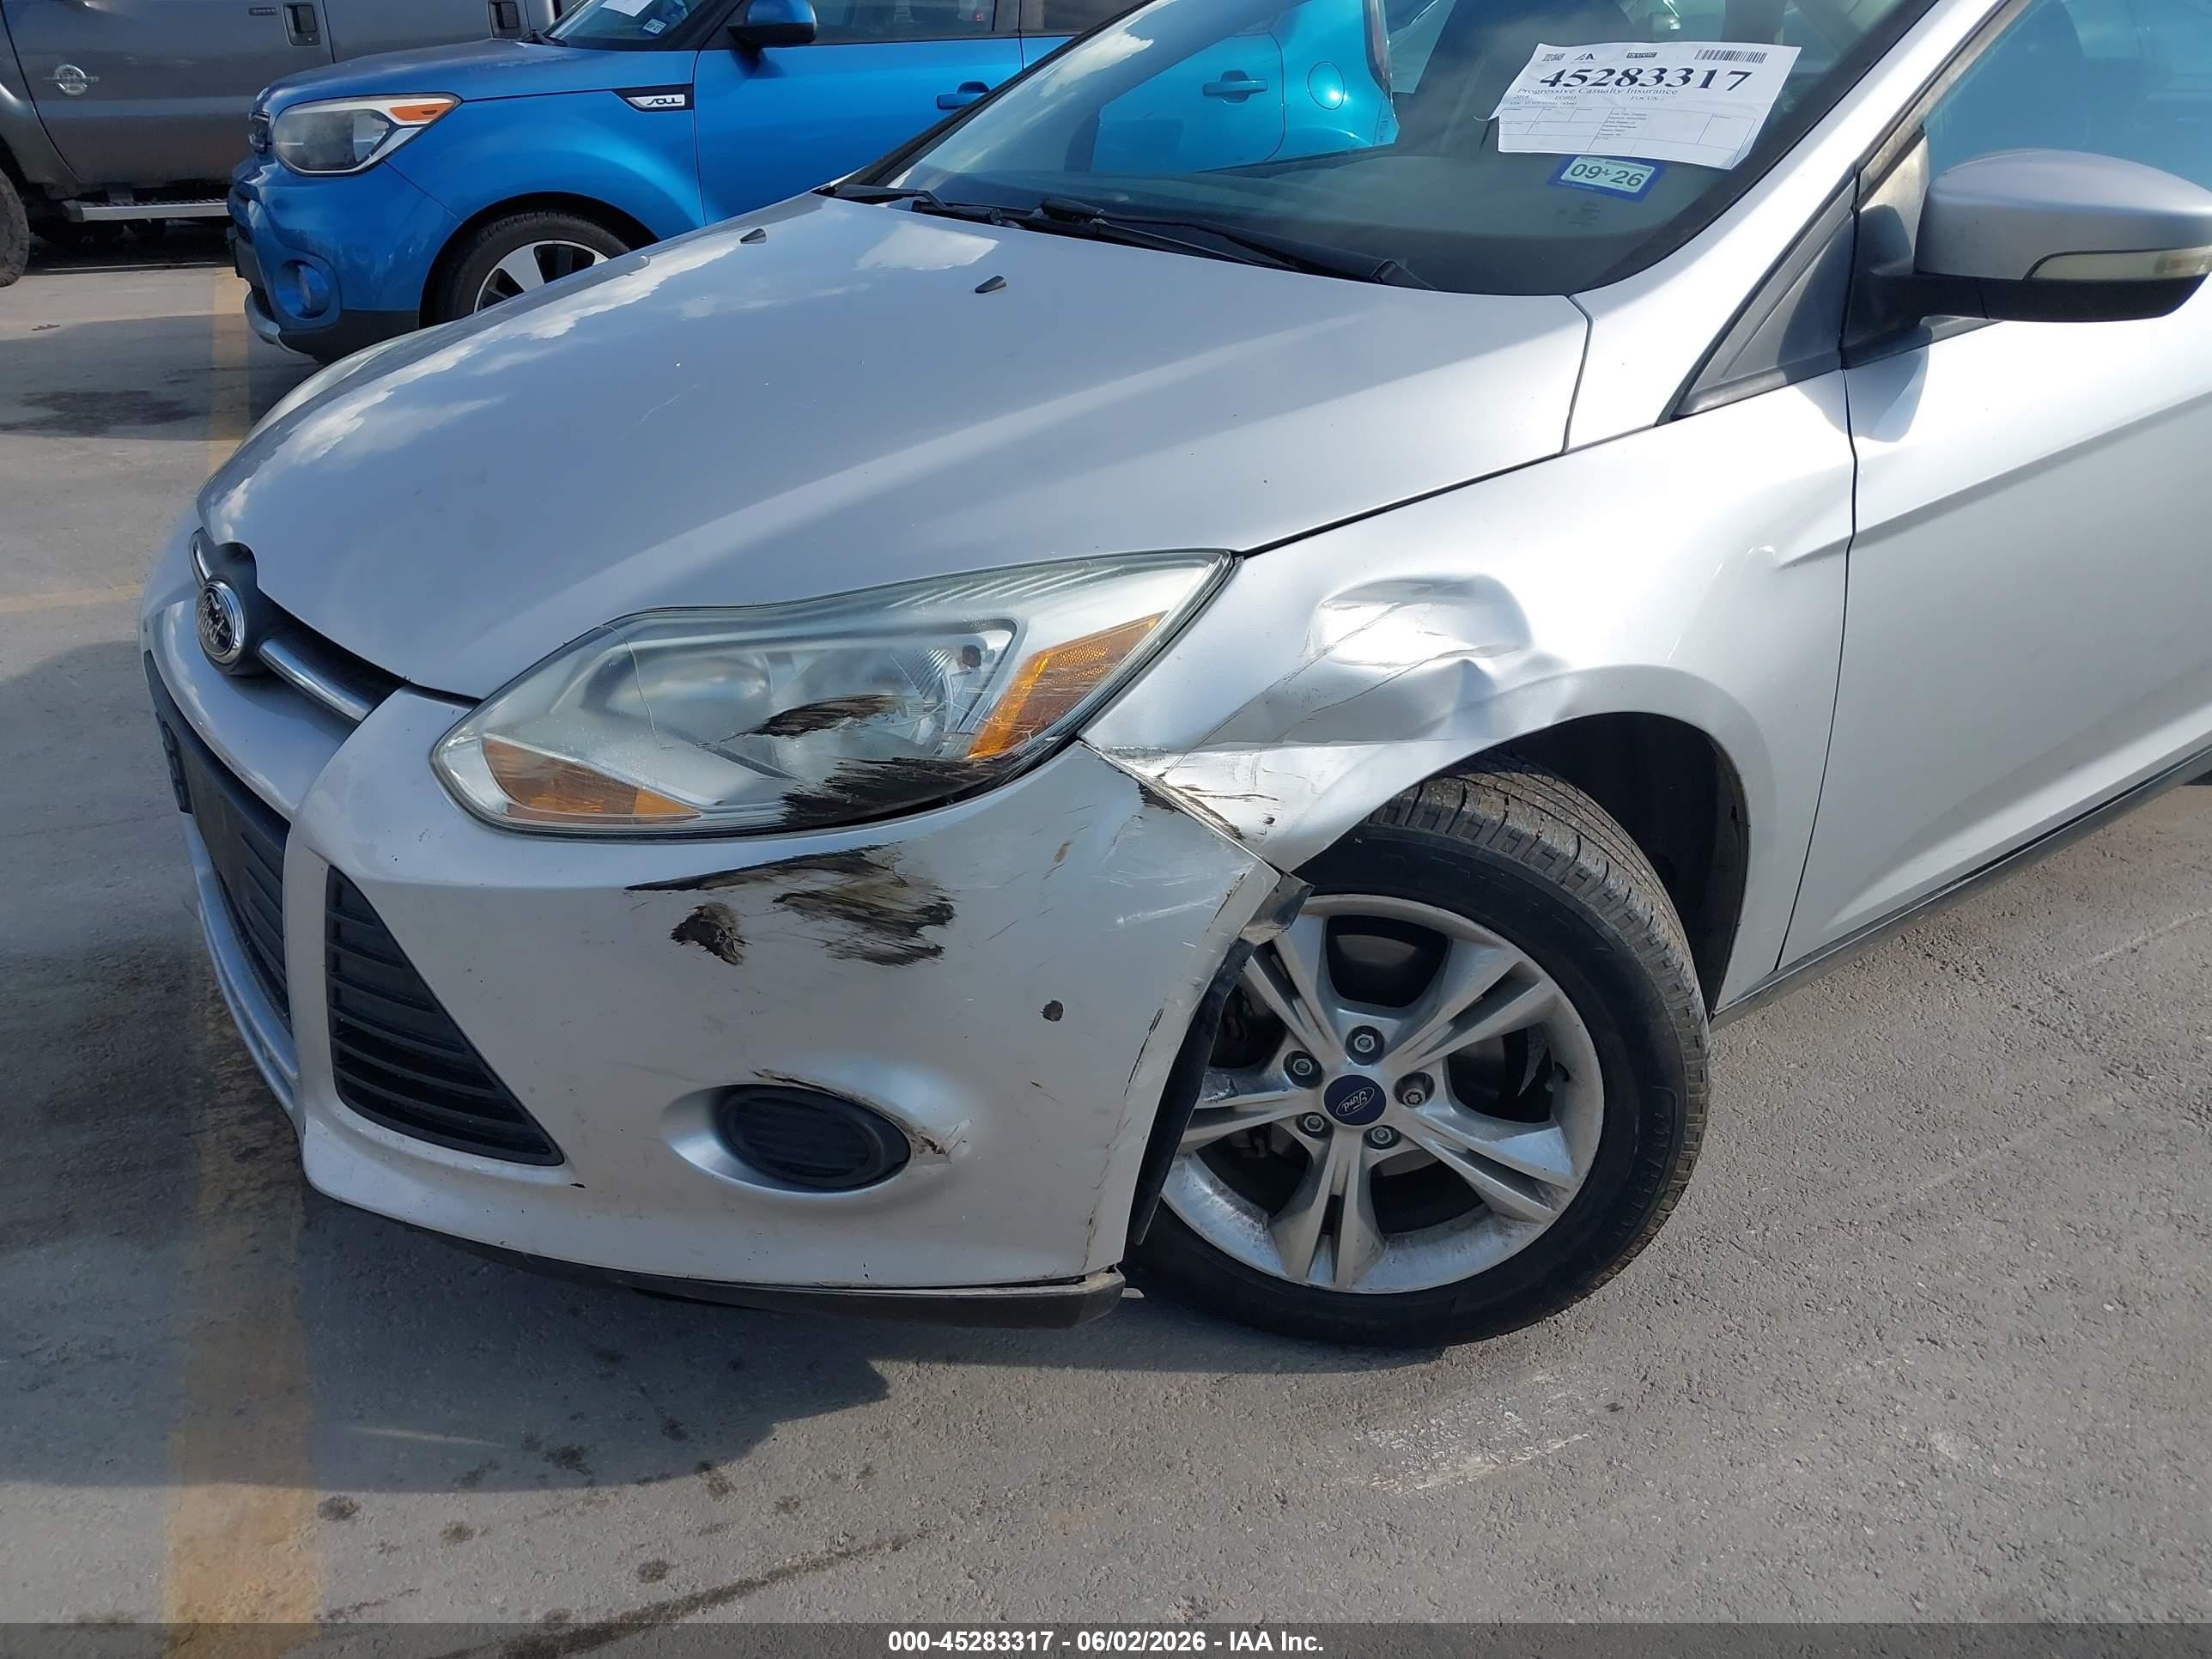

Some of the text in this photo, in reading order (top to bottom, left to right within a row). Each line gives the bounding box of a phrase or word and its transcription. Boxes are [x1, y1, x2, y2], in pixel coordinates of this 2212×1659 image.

[1540, 67, 1753, 91] 45283317
[1570, 164, 1603, 179] 09
[1610, 170, 1645, 187] 26
[1341, 1091, 1368, 1112] Ford
